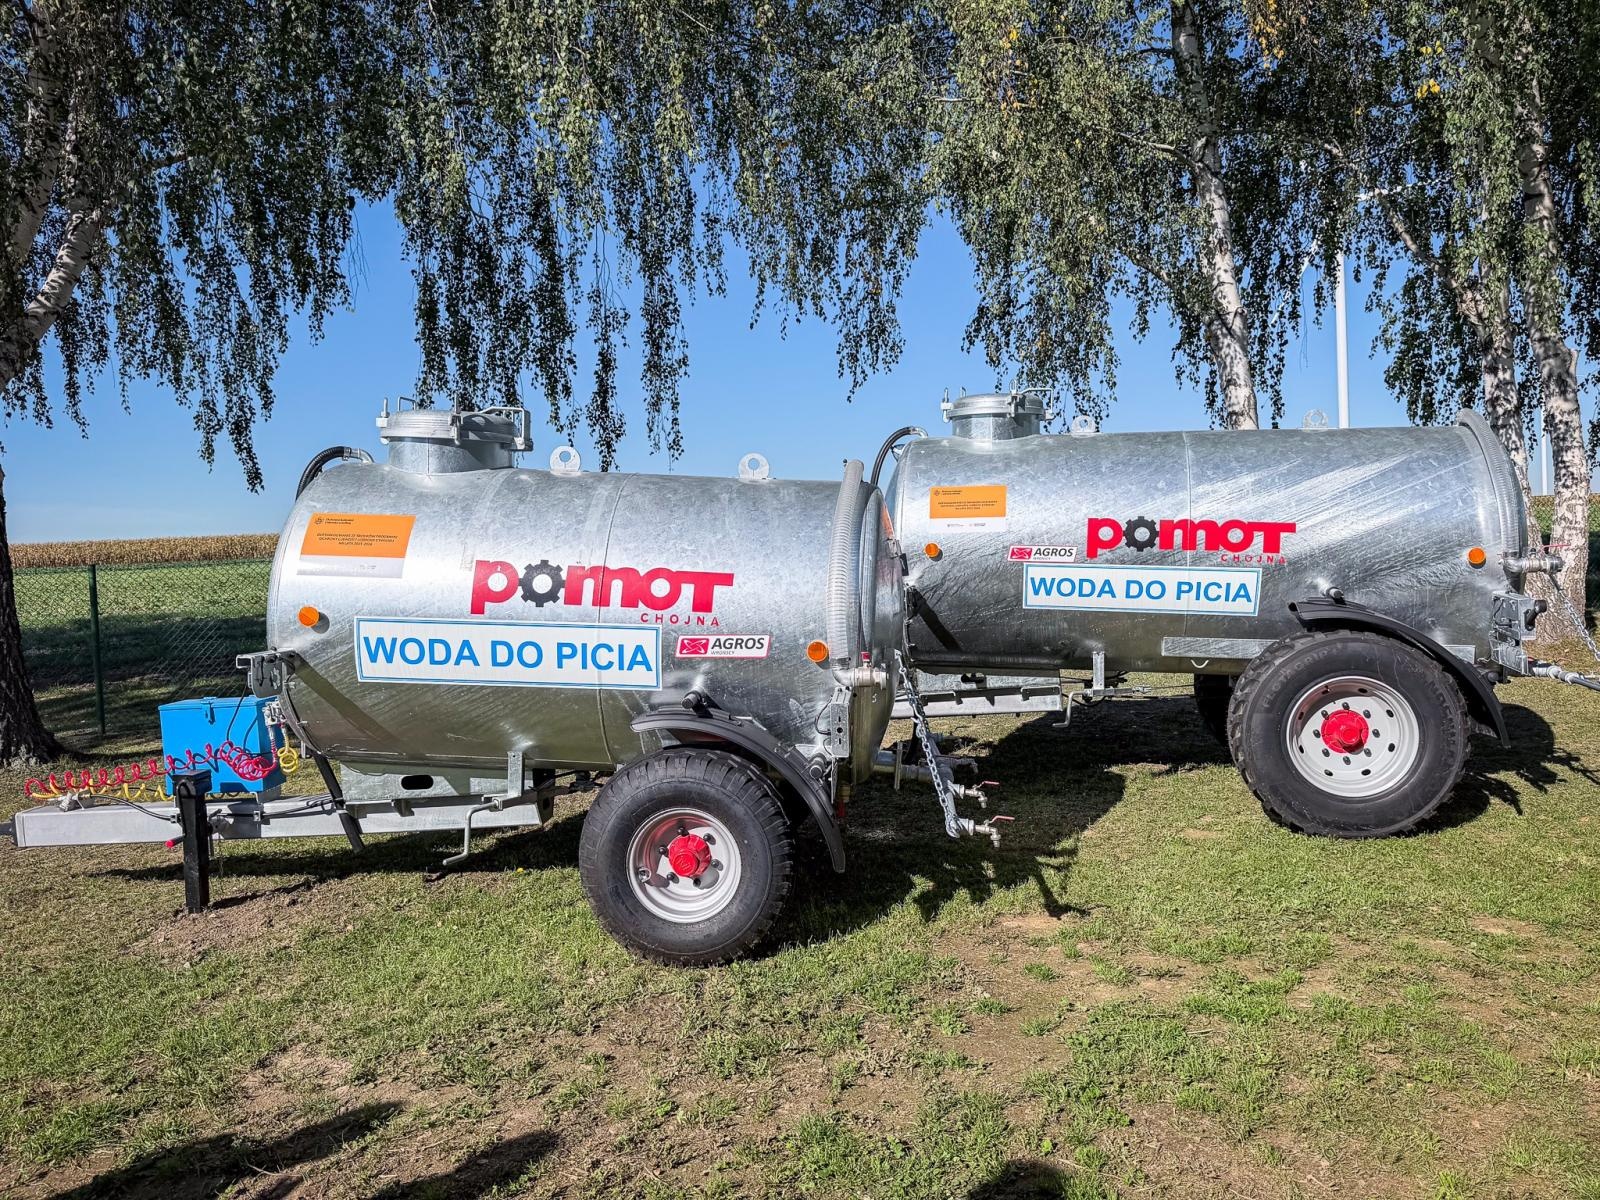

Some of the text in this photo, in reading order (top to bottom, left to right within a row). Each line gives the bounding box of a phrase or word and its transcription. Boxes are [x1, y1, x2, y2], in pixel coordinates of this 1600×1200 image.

[1033, 547, 1075, 557] AGROS
[1220, 553, 1288, 565] CHOJNA
[1030, 576, 1253, 603] WODA DO PICIA
[640, 612, 720, 627] CHOJNA
[710, 637, 765, 650] AGROS
[362, 635, 653, 673] WODA DO PICIA
